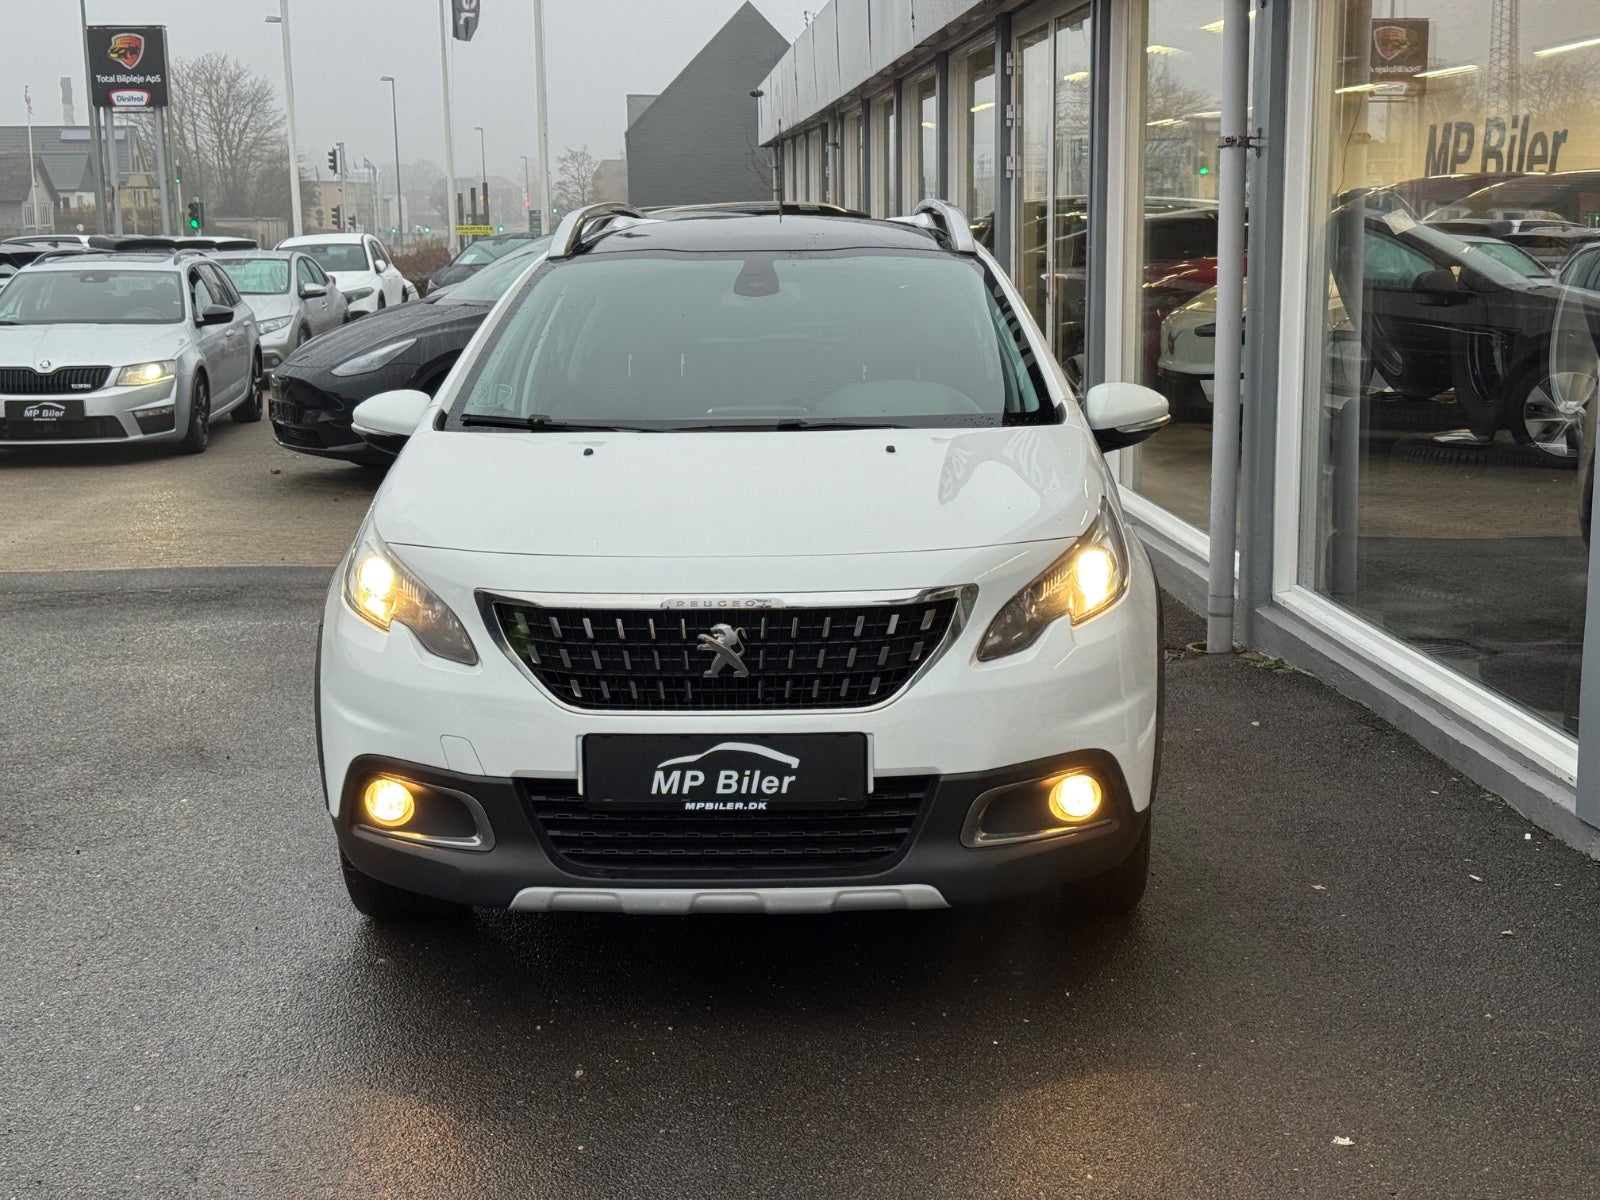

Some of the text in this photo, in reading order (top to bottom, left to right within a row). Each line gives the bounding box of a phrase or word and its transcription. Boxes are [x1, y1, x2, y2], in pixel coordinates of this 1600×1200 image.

[96, 74, 162, 84] Total Bilpleje ApS
[116, 95, 144, 103] Dinitrol
[1424, 113, 1569, 177] MP Biler
[24, 408, 65, 418] MP Biler
[676, 600, 772, 609] PEUGEOT
[650, 769, 797, 795] MP Biler
[684, 801, 768, 811] MPBILER.DK
